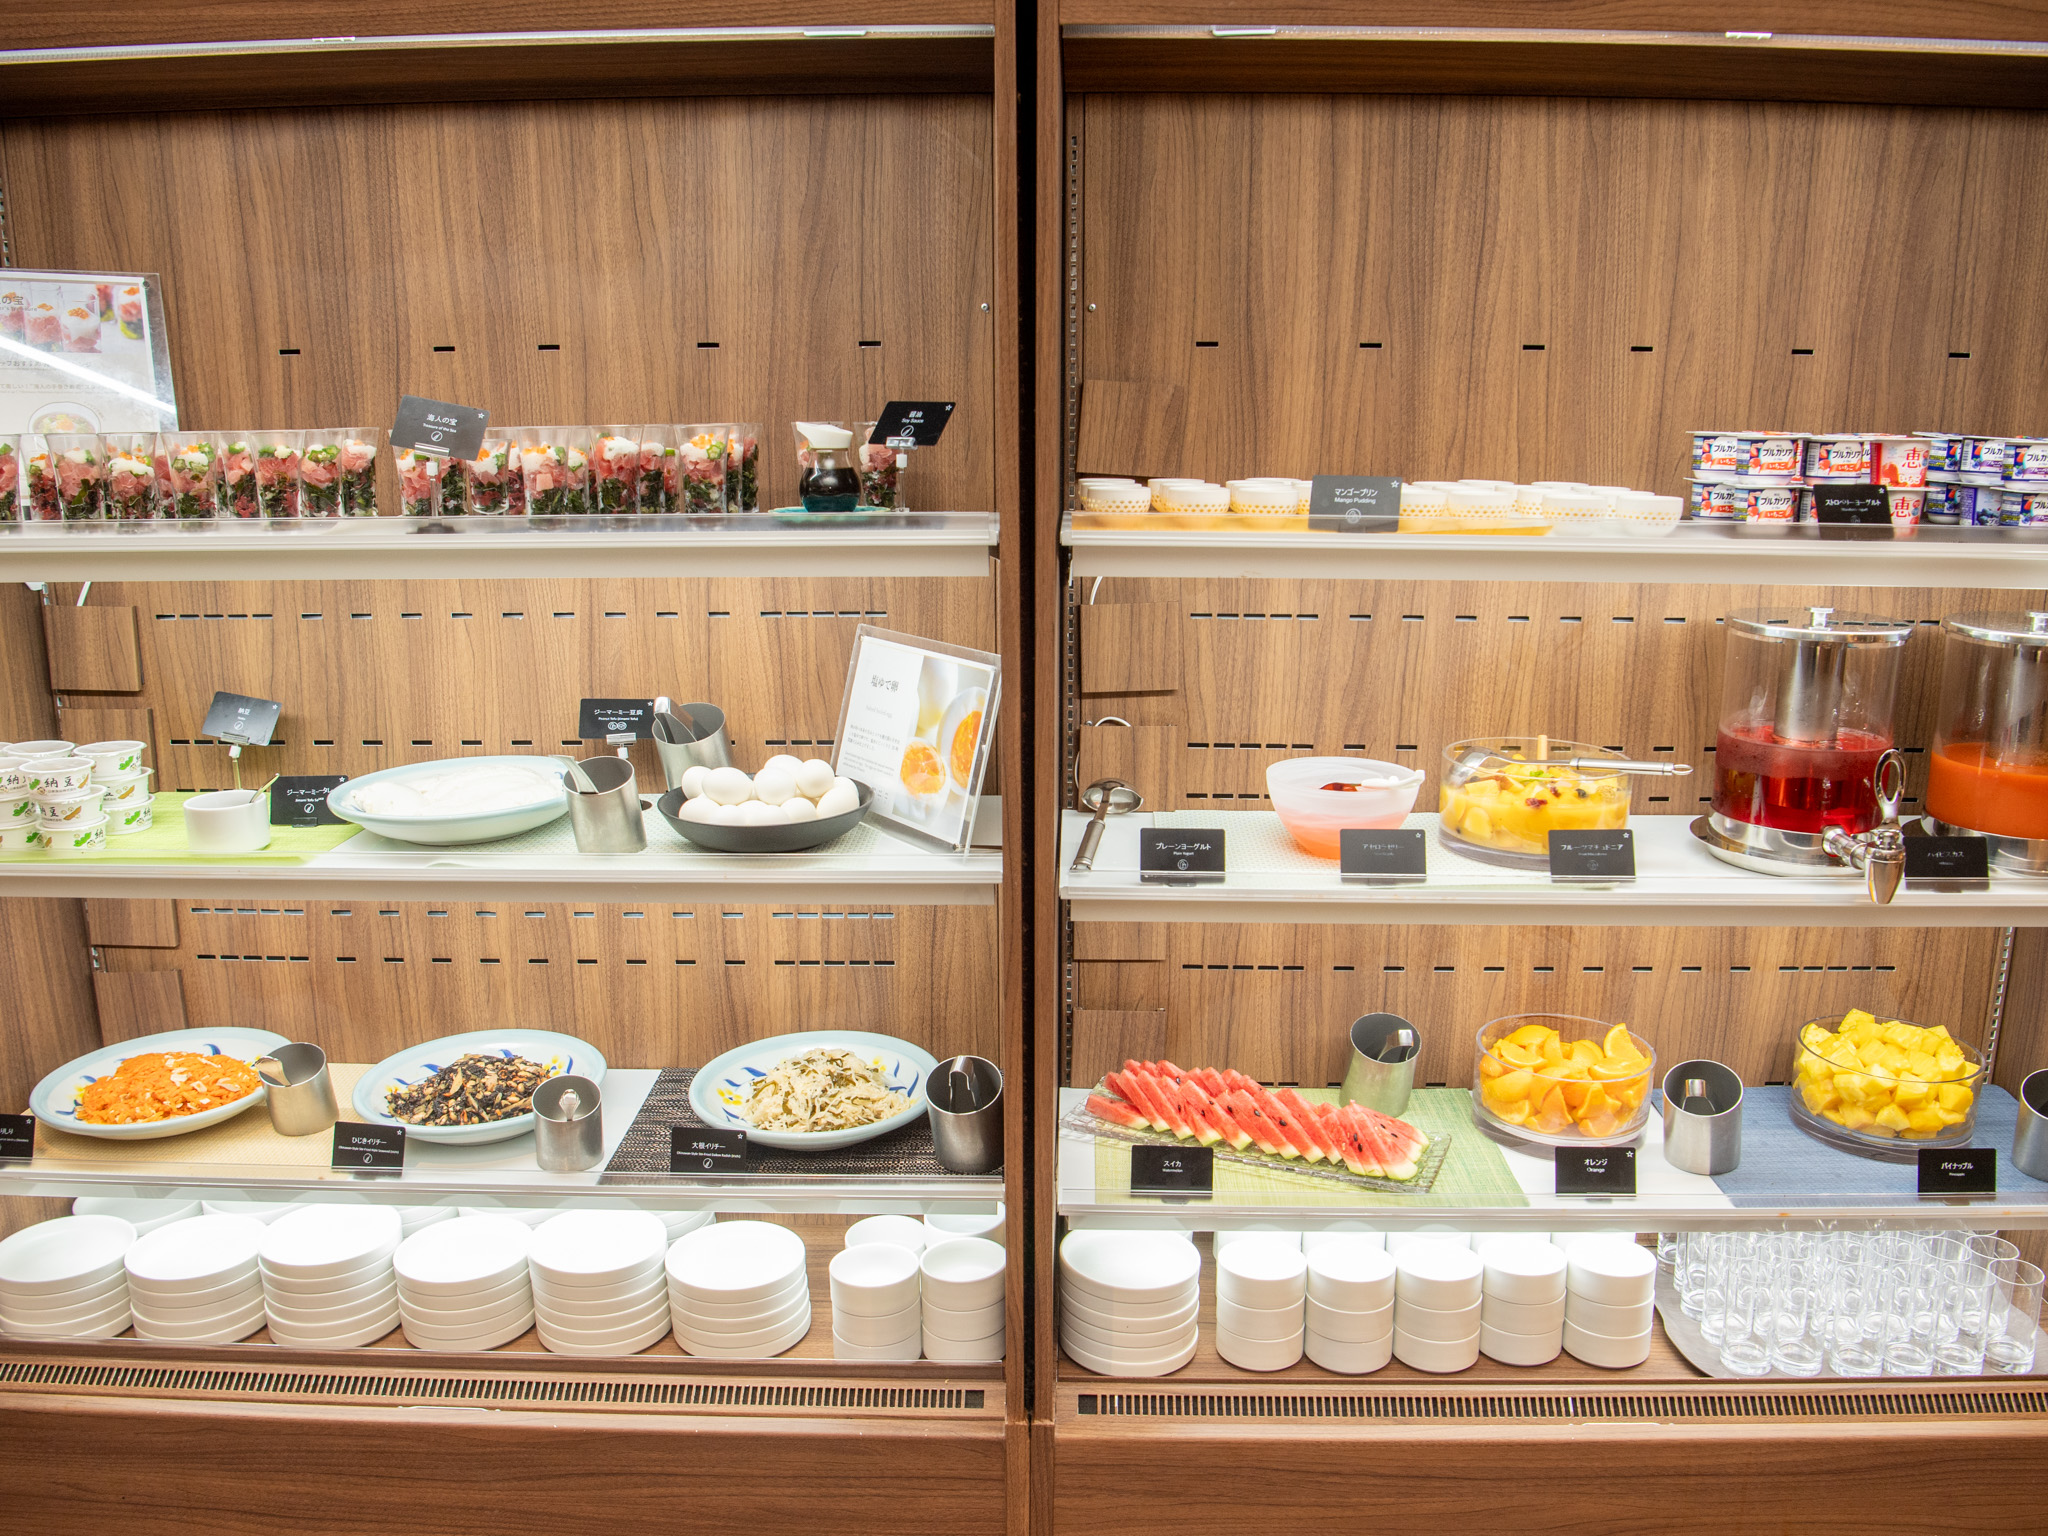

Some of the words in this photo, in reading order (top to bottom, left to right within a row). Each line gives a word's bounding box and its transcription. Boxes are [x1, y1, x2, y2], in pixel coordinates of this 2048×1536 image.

[0, 296, 24, 305] の宝
[426, 414, 458, 426] 海人の宝
[1902, 446, 1922, 468] 恵
[1334, 488, 1378, 496] マンゴープリン
[1890, 496, 1910, 517] 恵
[44, 776, 74, 788] 納豆
[1156, 842, 1211, 850] プレーンヨーグルト
[352, 1137, 387, 1145] ひじきイリチー
[692, 1141, 726, 1150] 大根イリチー
[1584, 1158, 1608, 1166] オレンジ
[1941, 1162, 1974, 1170] パイナップル
